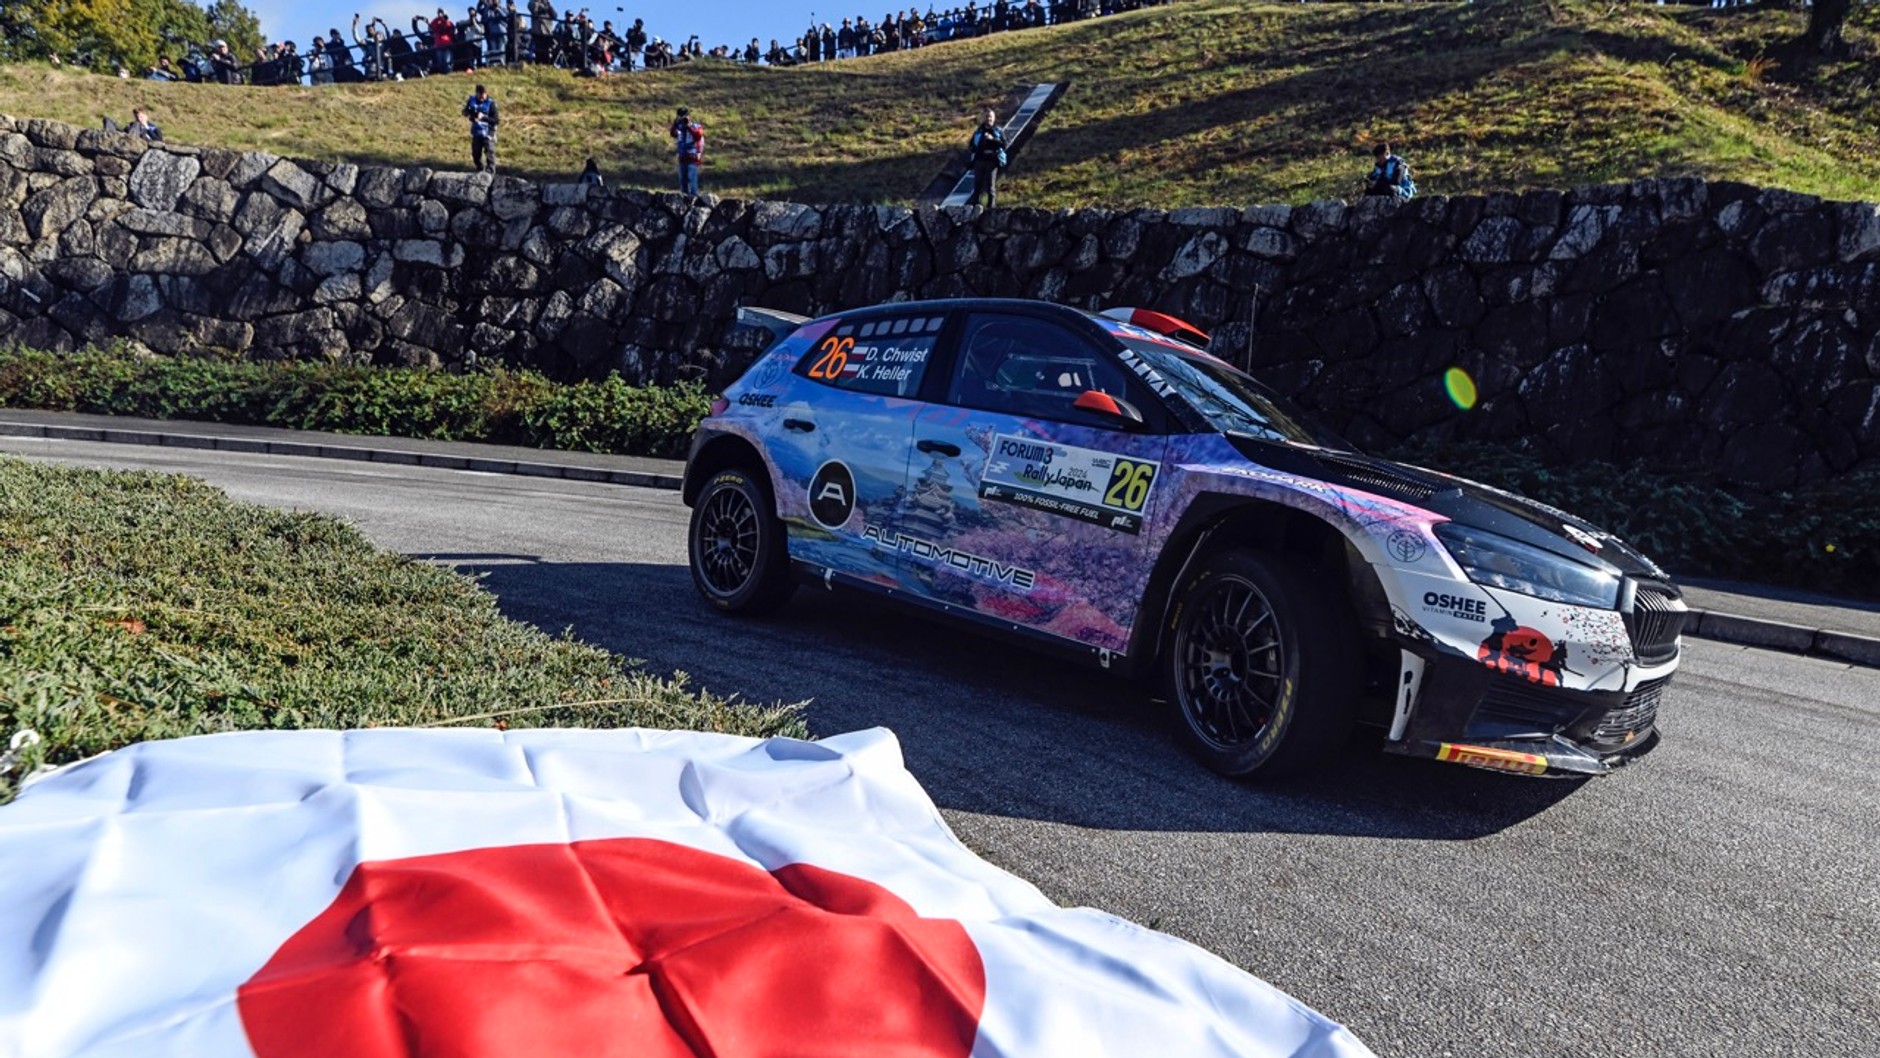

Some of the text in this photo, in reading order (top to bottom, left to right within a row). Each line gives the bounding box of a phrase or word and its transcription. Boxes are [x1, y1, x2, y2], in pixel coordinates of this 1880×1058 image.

[808, 336, 854, 379] 26
[866, 348, 928, 363] D. Chwist
[856, 364, 912, 380] K. Heller
[739, 393, 777, 408] OSHEE
[1067, 467, 1088, 478] 2024
[1104, 460, 1153, 510] 26
[1014, 492, 1100, 519] 100% FOSSIL-FREE FUEL
[861, 525, 1036, 589] AUTOMOTIVE
[1423, 592, 1486, 615] OSHEE
[1422, 606, 1485, 622] VITAMIN WATER
